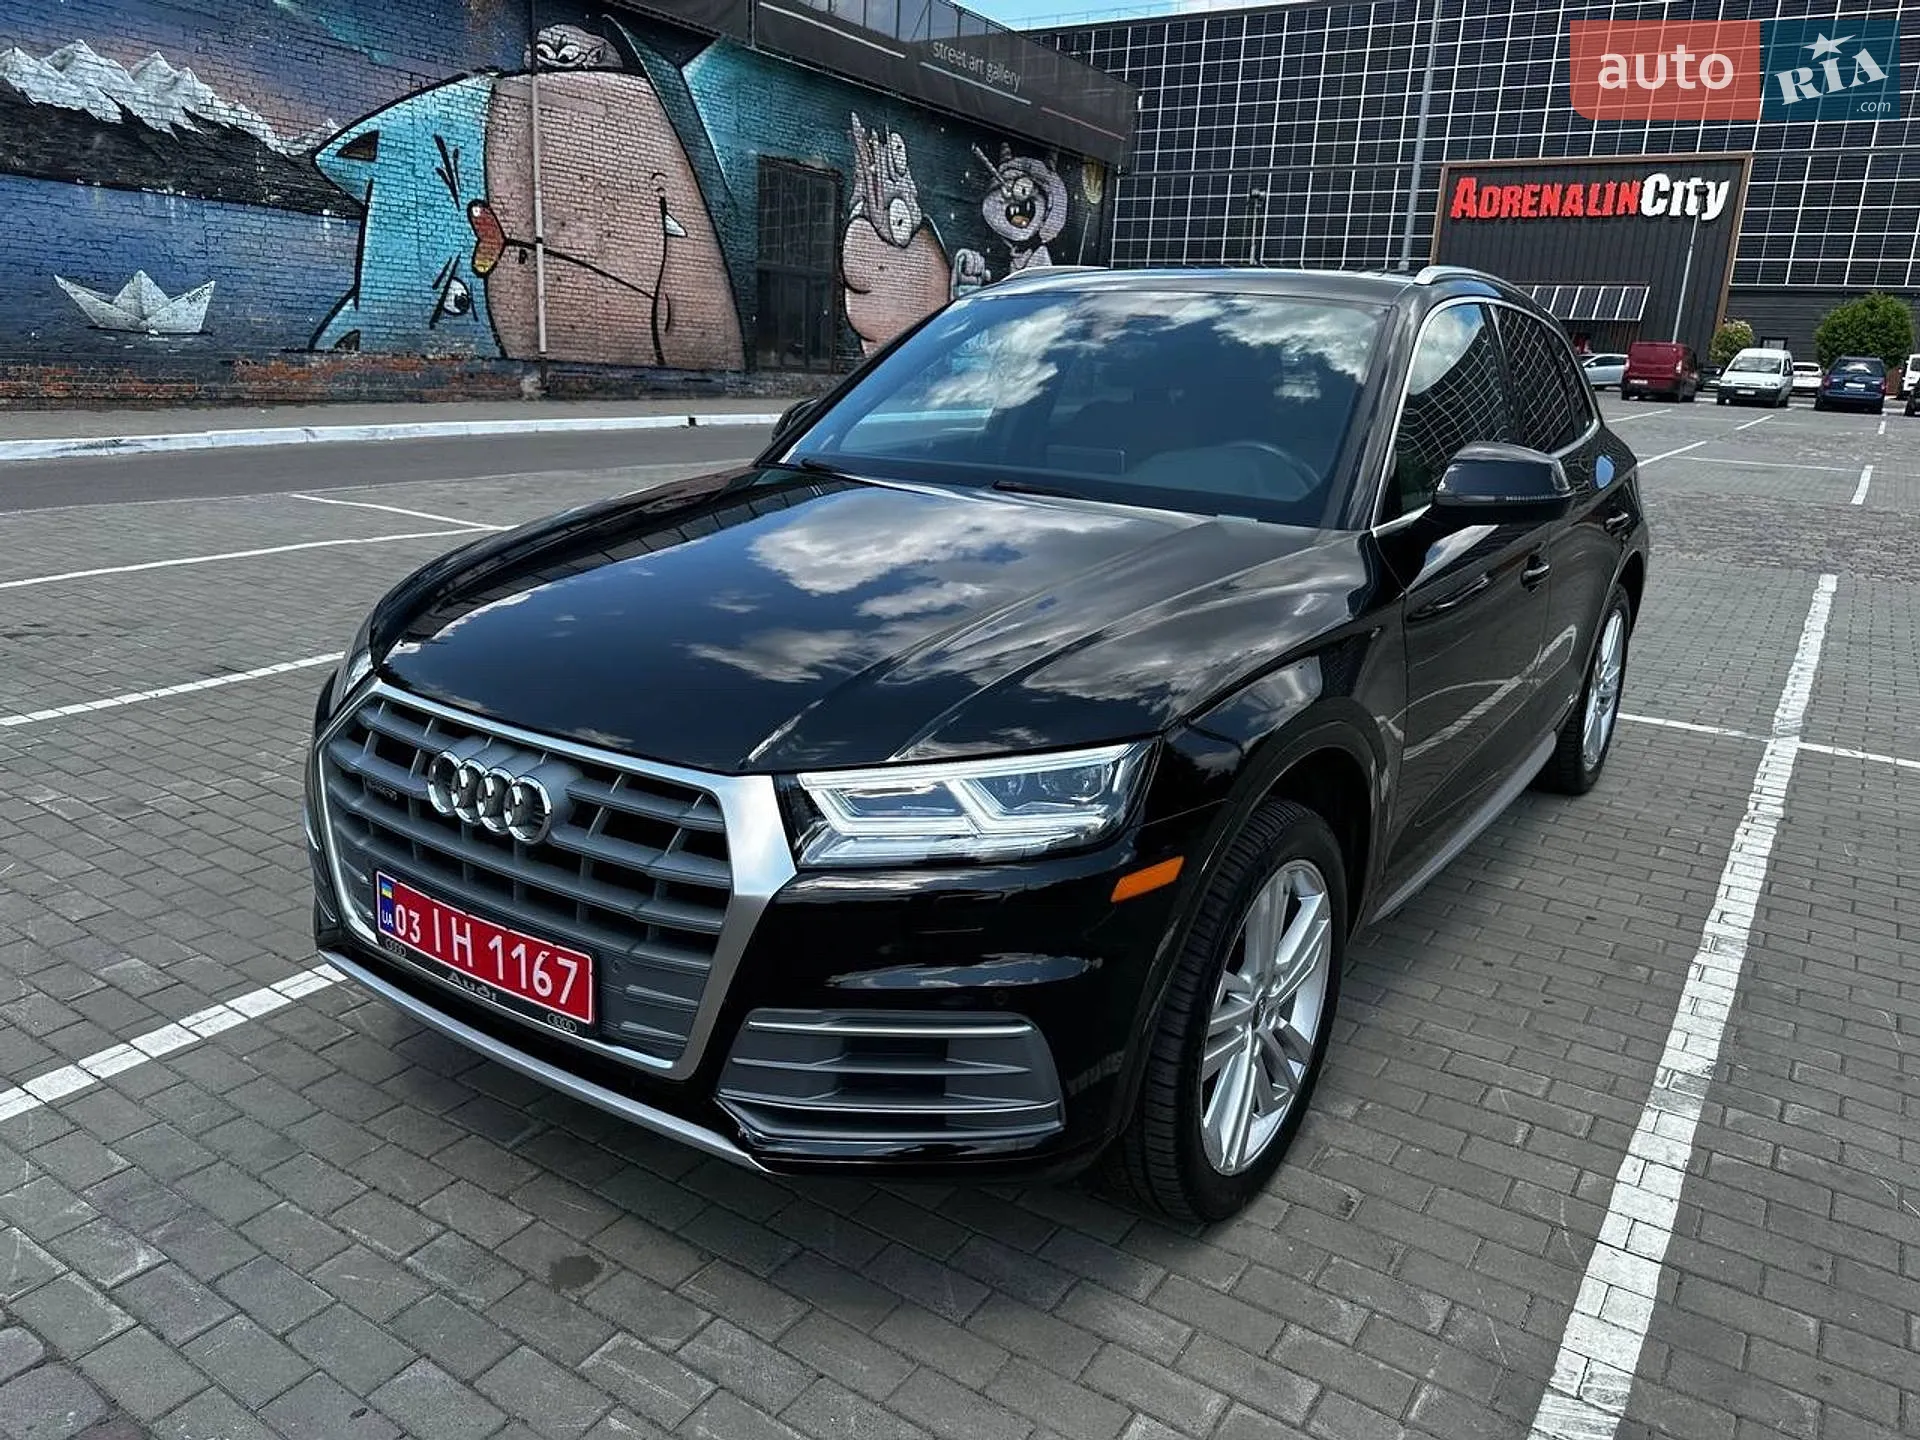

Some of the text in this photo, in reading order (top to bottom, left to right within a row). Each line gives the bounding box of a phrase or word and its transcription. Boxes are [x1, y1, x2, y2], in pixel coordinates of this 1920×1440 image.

[968, 56, 985, 75] art
[985, 62, 1021, 93] gallery
[381, 910, 394, 927] UA
[395, 904, 421, 944] 03
[488, 935, 578, 1005] 1167
